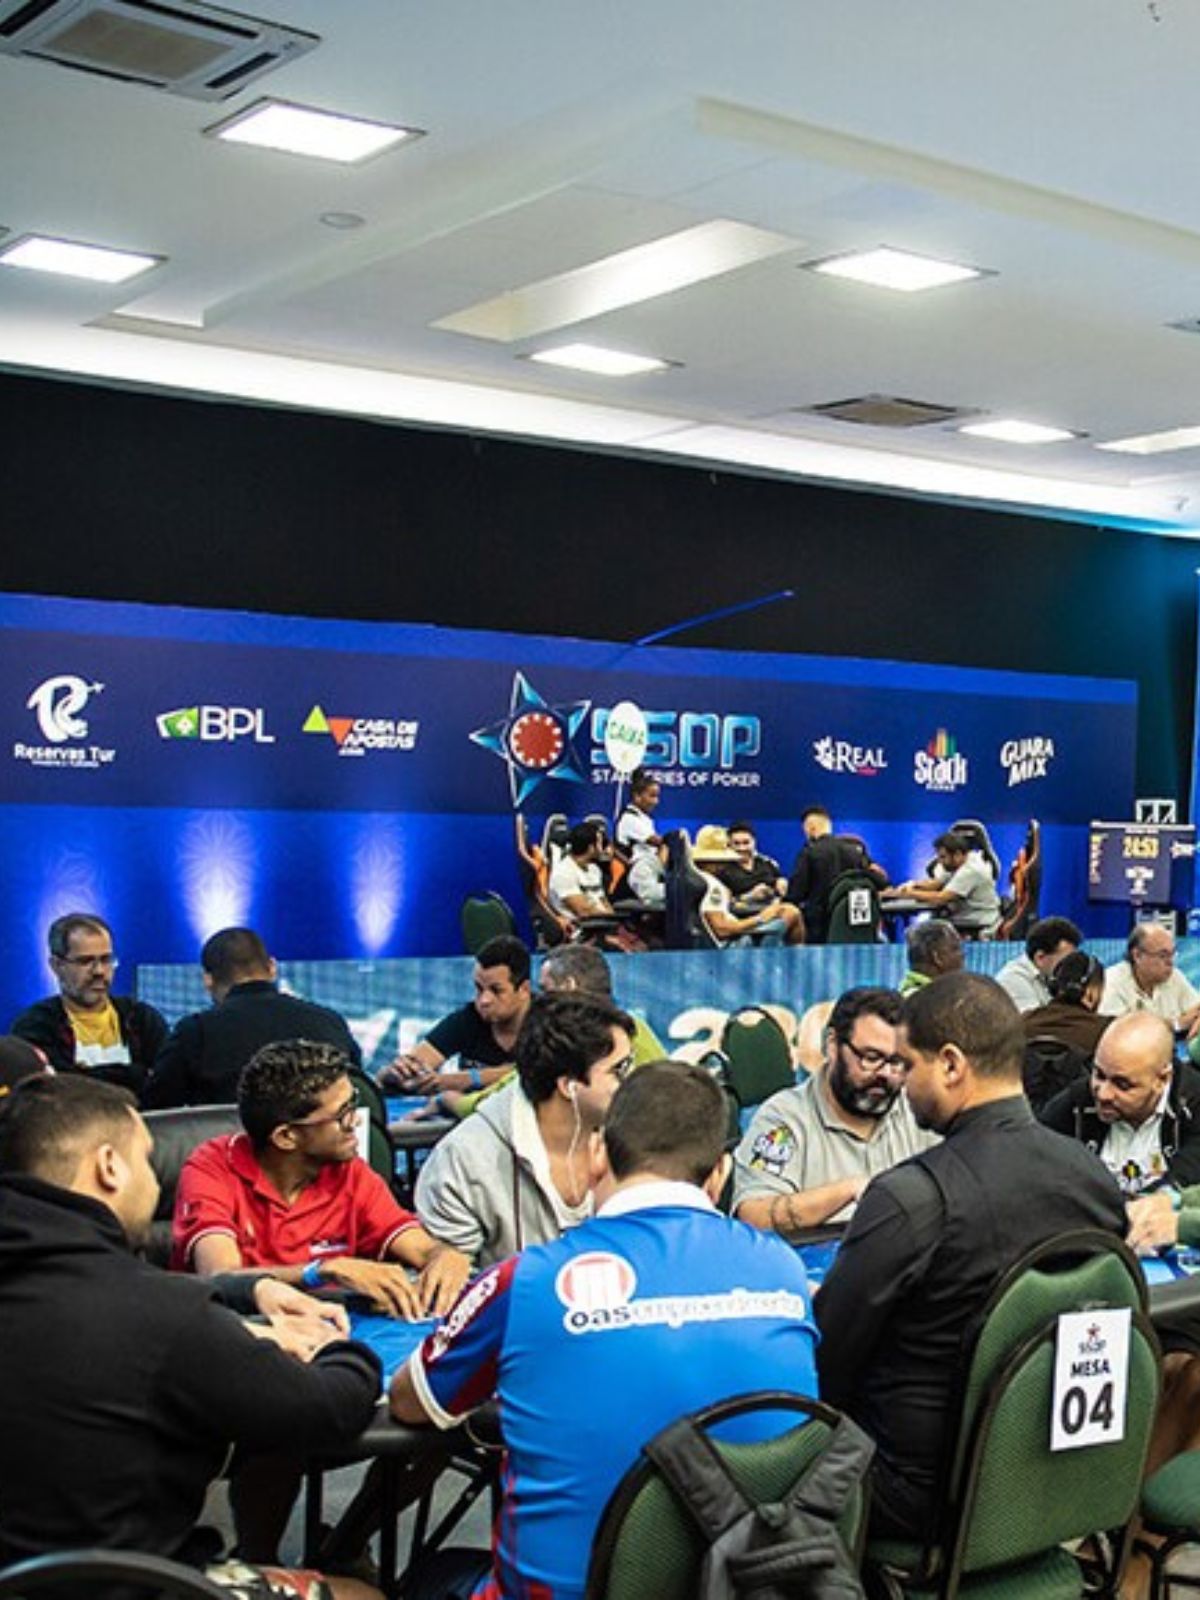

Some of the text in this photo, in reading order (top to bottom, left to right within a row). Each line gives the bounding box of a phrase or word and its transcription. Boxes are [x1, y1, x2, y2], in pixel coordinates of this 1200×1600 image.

[200, 705, 275, 743] BPL
[14, 743, 116, 763] Reservas Tur
[1001, 737, 1054, 768] GUARA
[688, 772, 708, 785] OF
[712, 772, 760, 787] POKER
[1008, 757, 1046, 787] MIX
[1070, 1359, 1111, 1377] MESA
[1061, 1380, 1114, 1435] 04
